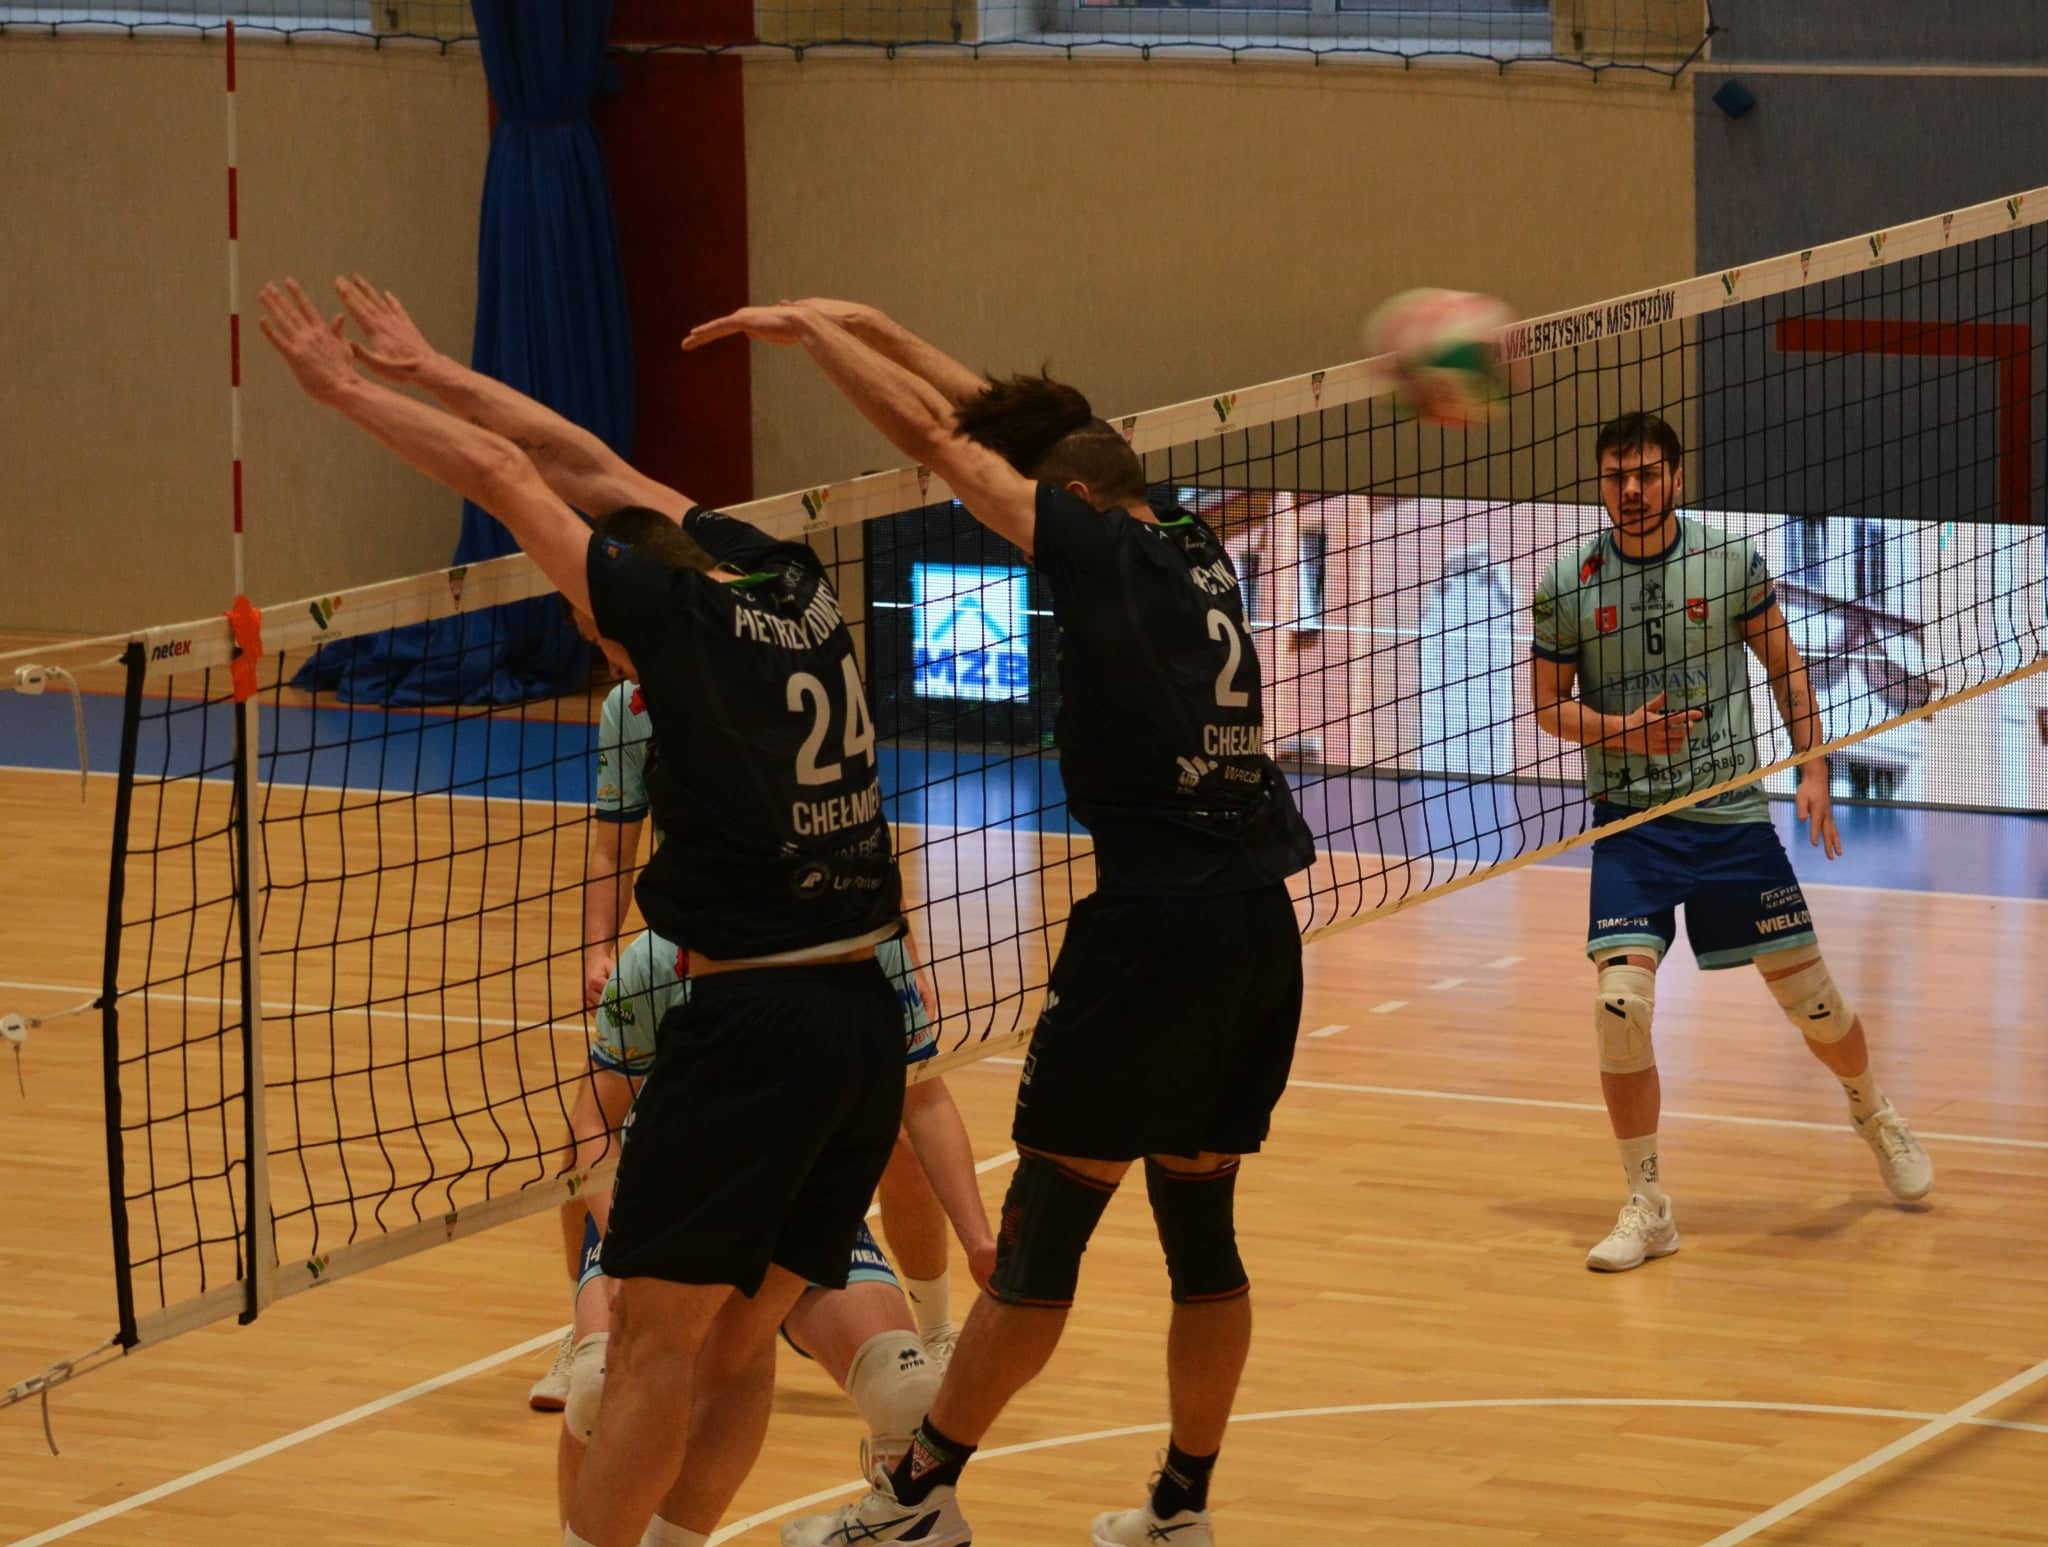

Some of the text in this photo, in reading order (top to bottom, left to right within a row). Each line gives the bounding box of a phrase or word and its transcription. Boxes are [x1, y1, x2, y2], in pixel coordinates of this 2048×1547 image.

[1504, 289, 1676, 361] WAŁBRZYSKICH MISTRZÓW
[151, 640, 192, 662] netex
[1645, 617, 1663, 656] 6
[786, 652, 876, 787] 24
